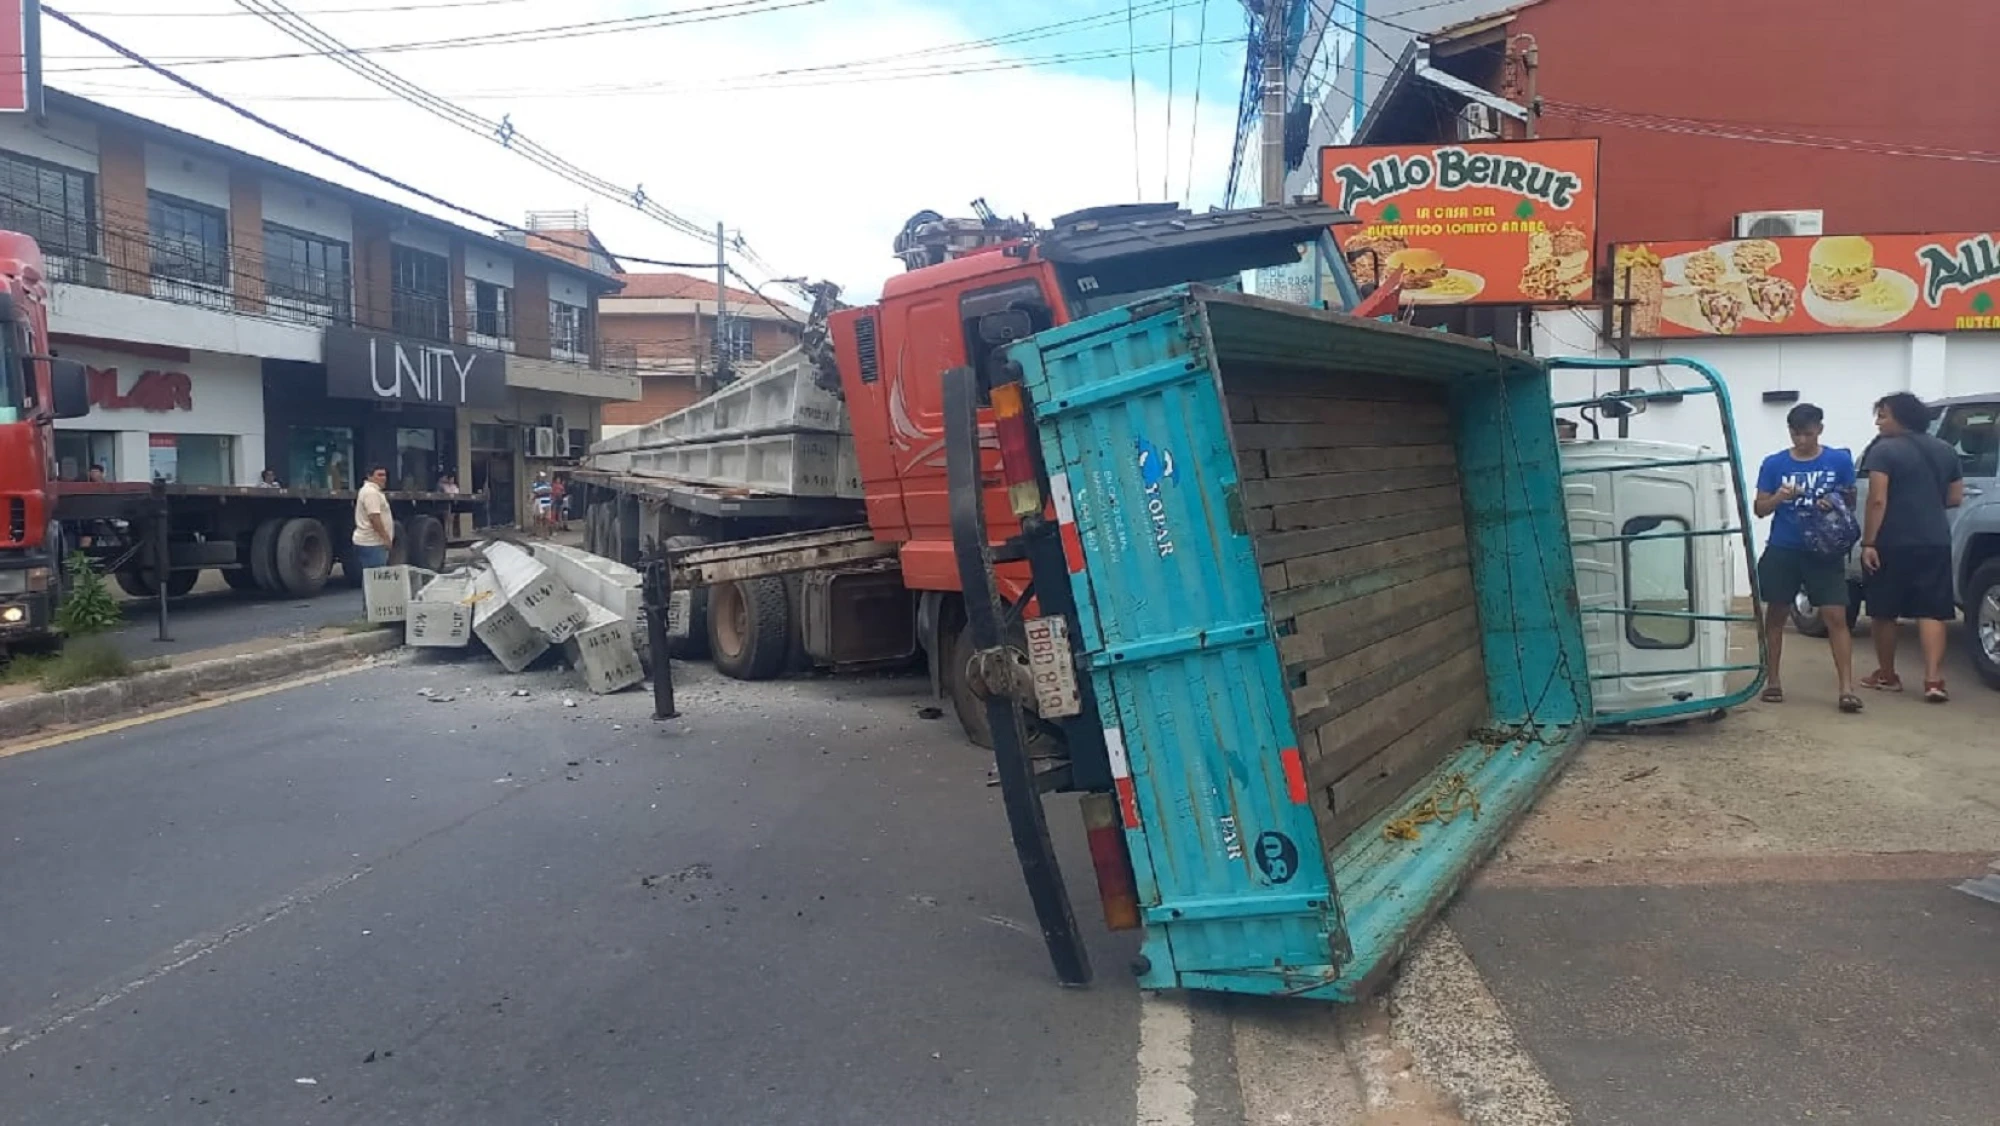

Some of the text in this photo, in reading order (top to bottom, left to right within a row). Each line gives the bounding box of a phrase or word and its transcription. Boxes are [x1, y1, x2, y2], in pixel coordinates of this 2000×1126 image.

[1416, 206, 1496, 219] LA CASA DEL
[1446, 223, 1498, 234] LOMITO
[370, 338, 477, 403] UNITY
